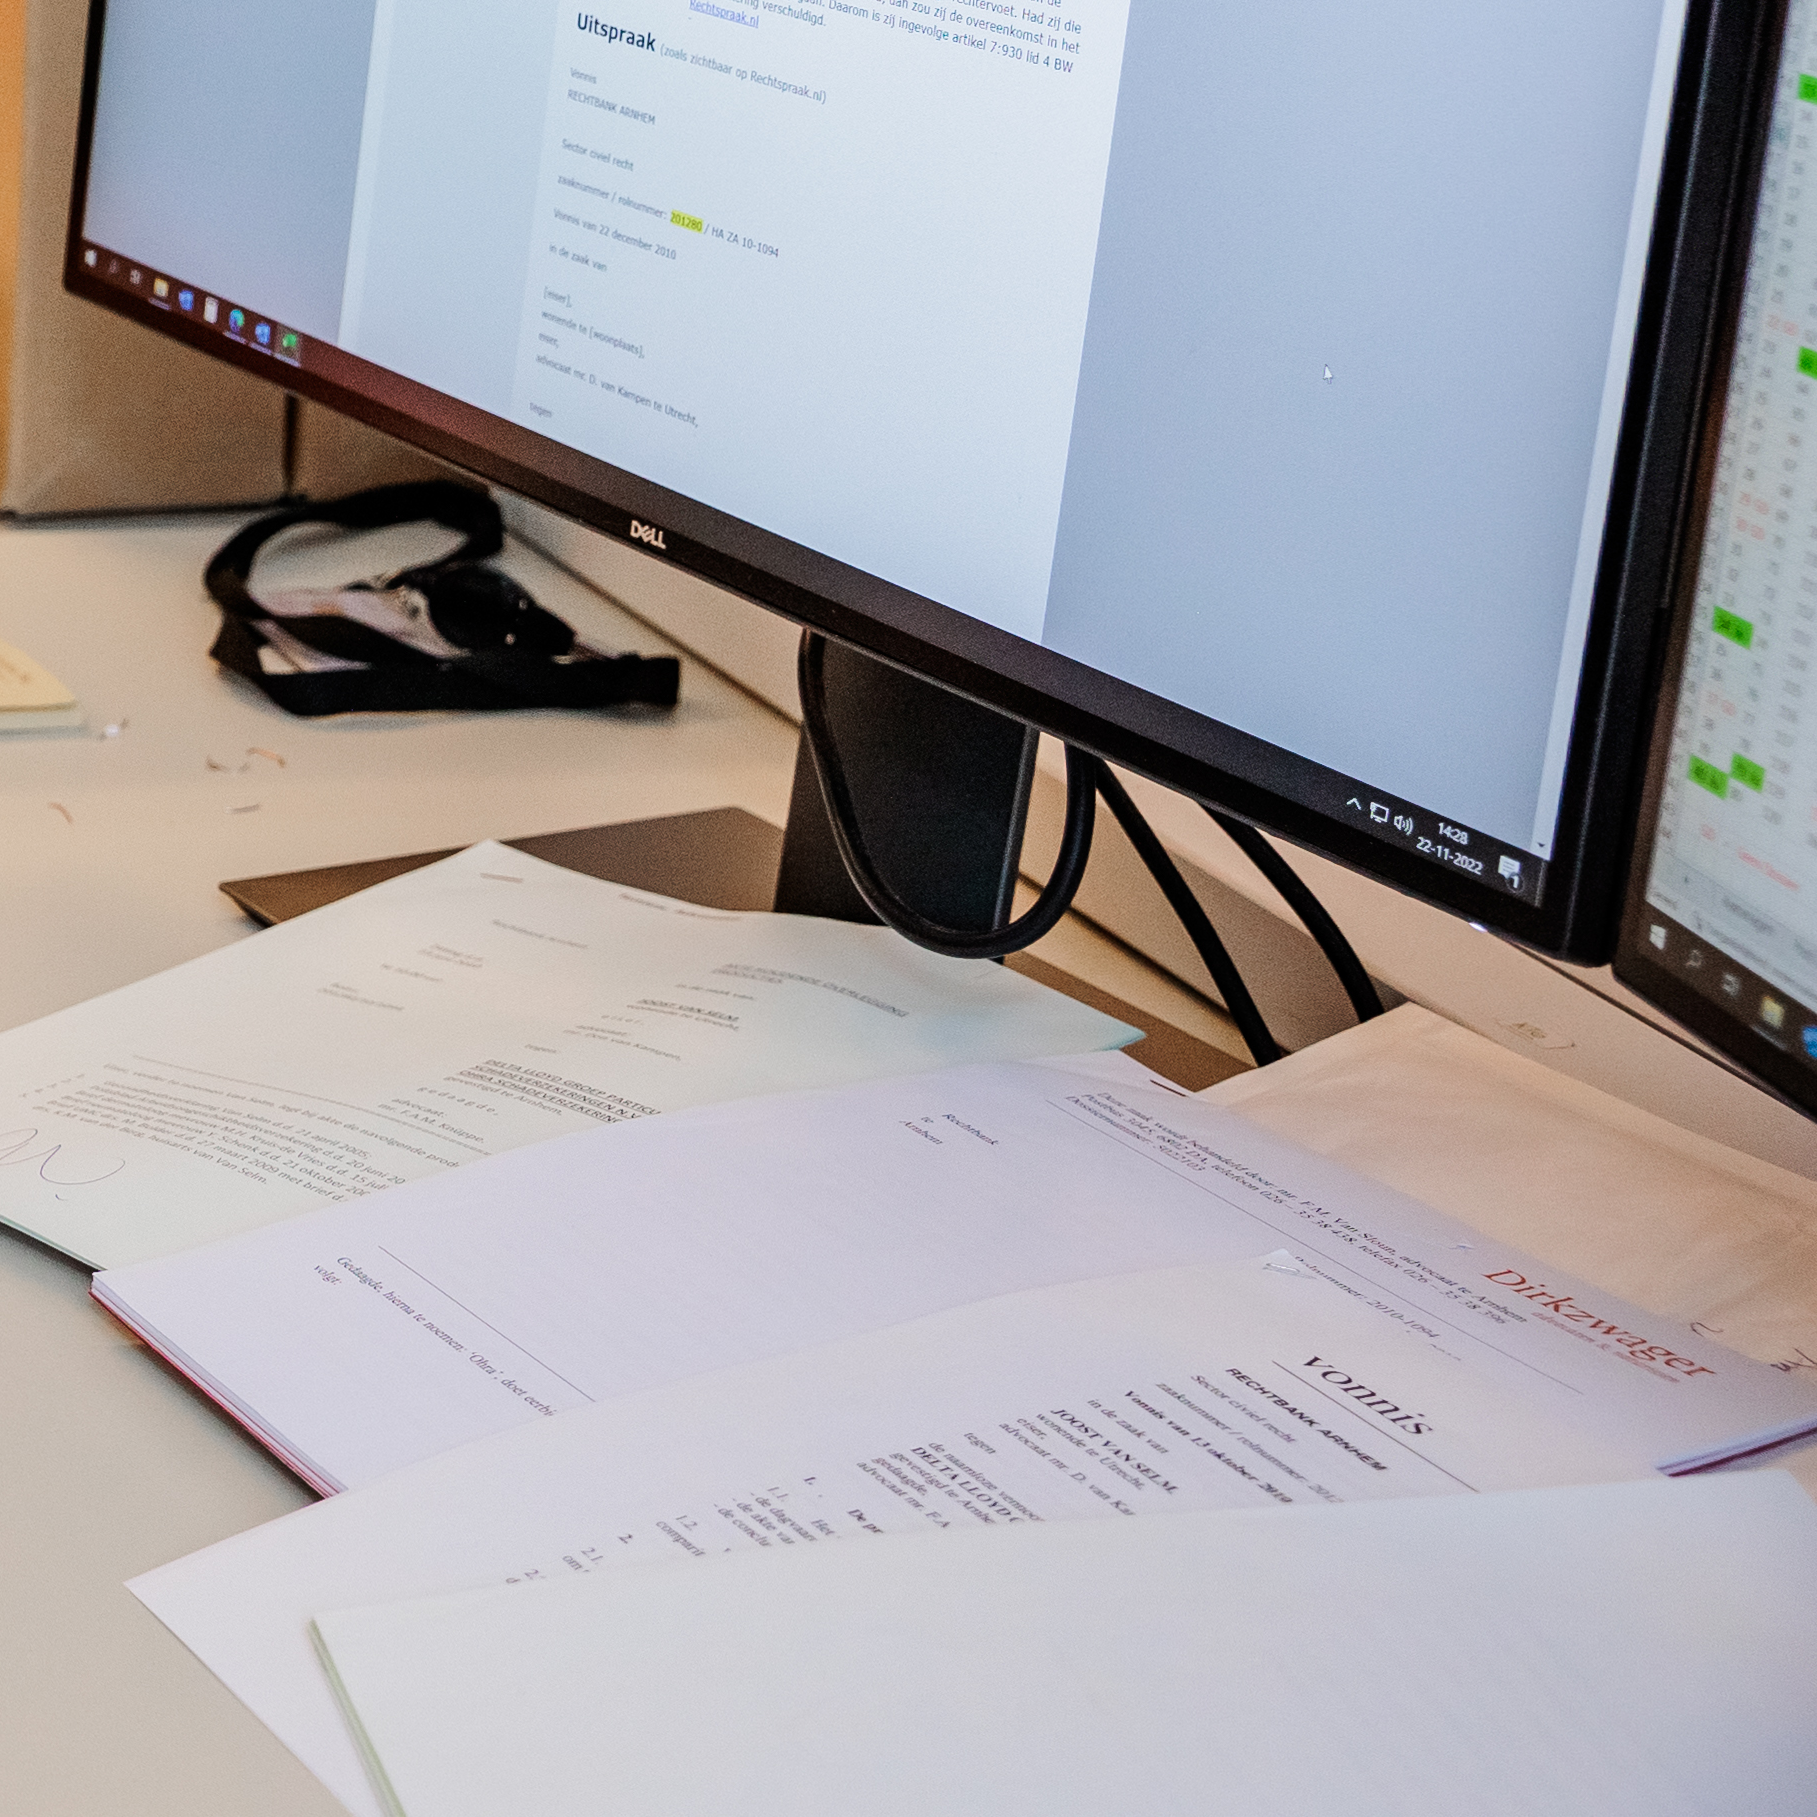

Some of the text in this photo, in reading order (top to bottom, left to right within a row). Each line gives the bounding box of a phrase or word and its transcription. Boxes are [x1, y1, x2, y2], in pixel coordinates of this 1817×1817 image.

[577, 12, 656, 52] Uitspraak
[630, 519, 667, 550] DELL
[1416, 836, 1484, 876] 22-11-2022
[1481, 1268, 1716, 1382] Dirkzwager
[523, 1396, 559, 1417] eerbi
[1303, 1355, 1433, 1434] vonnis
